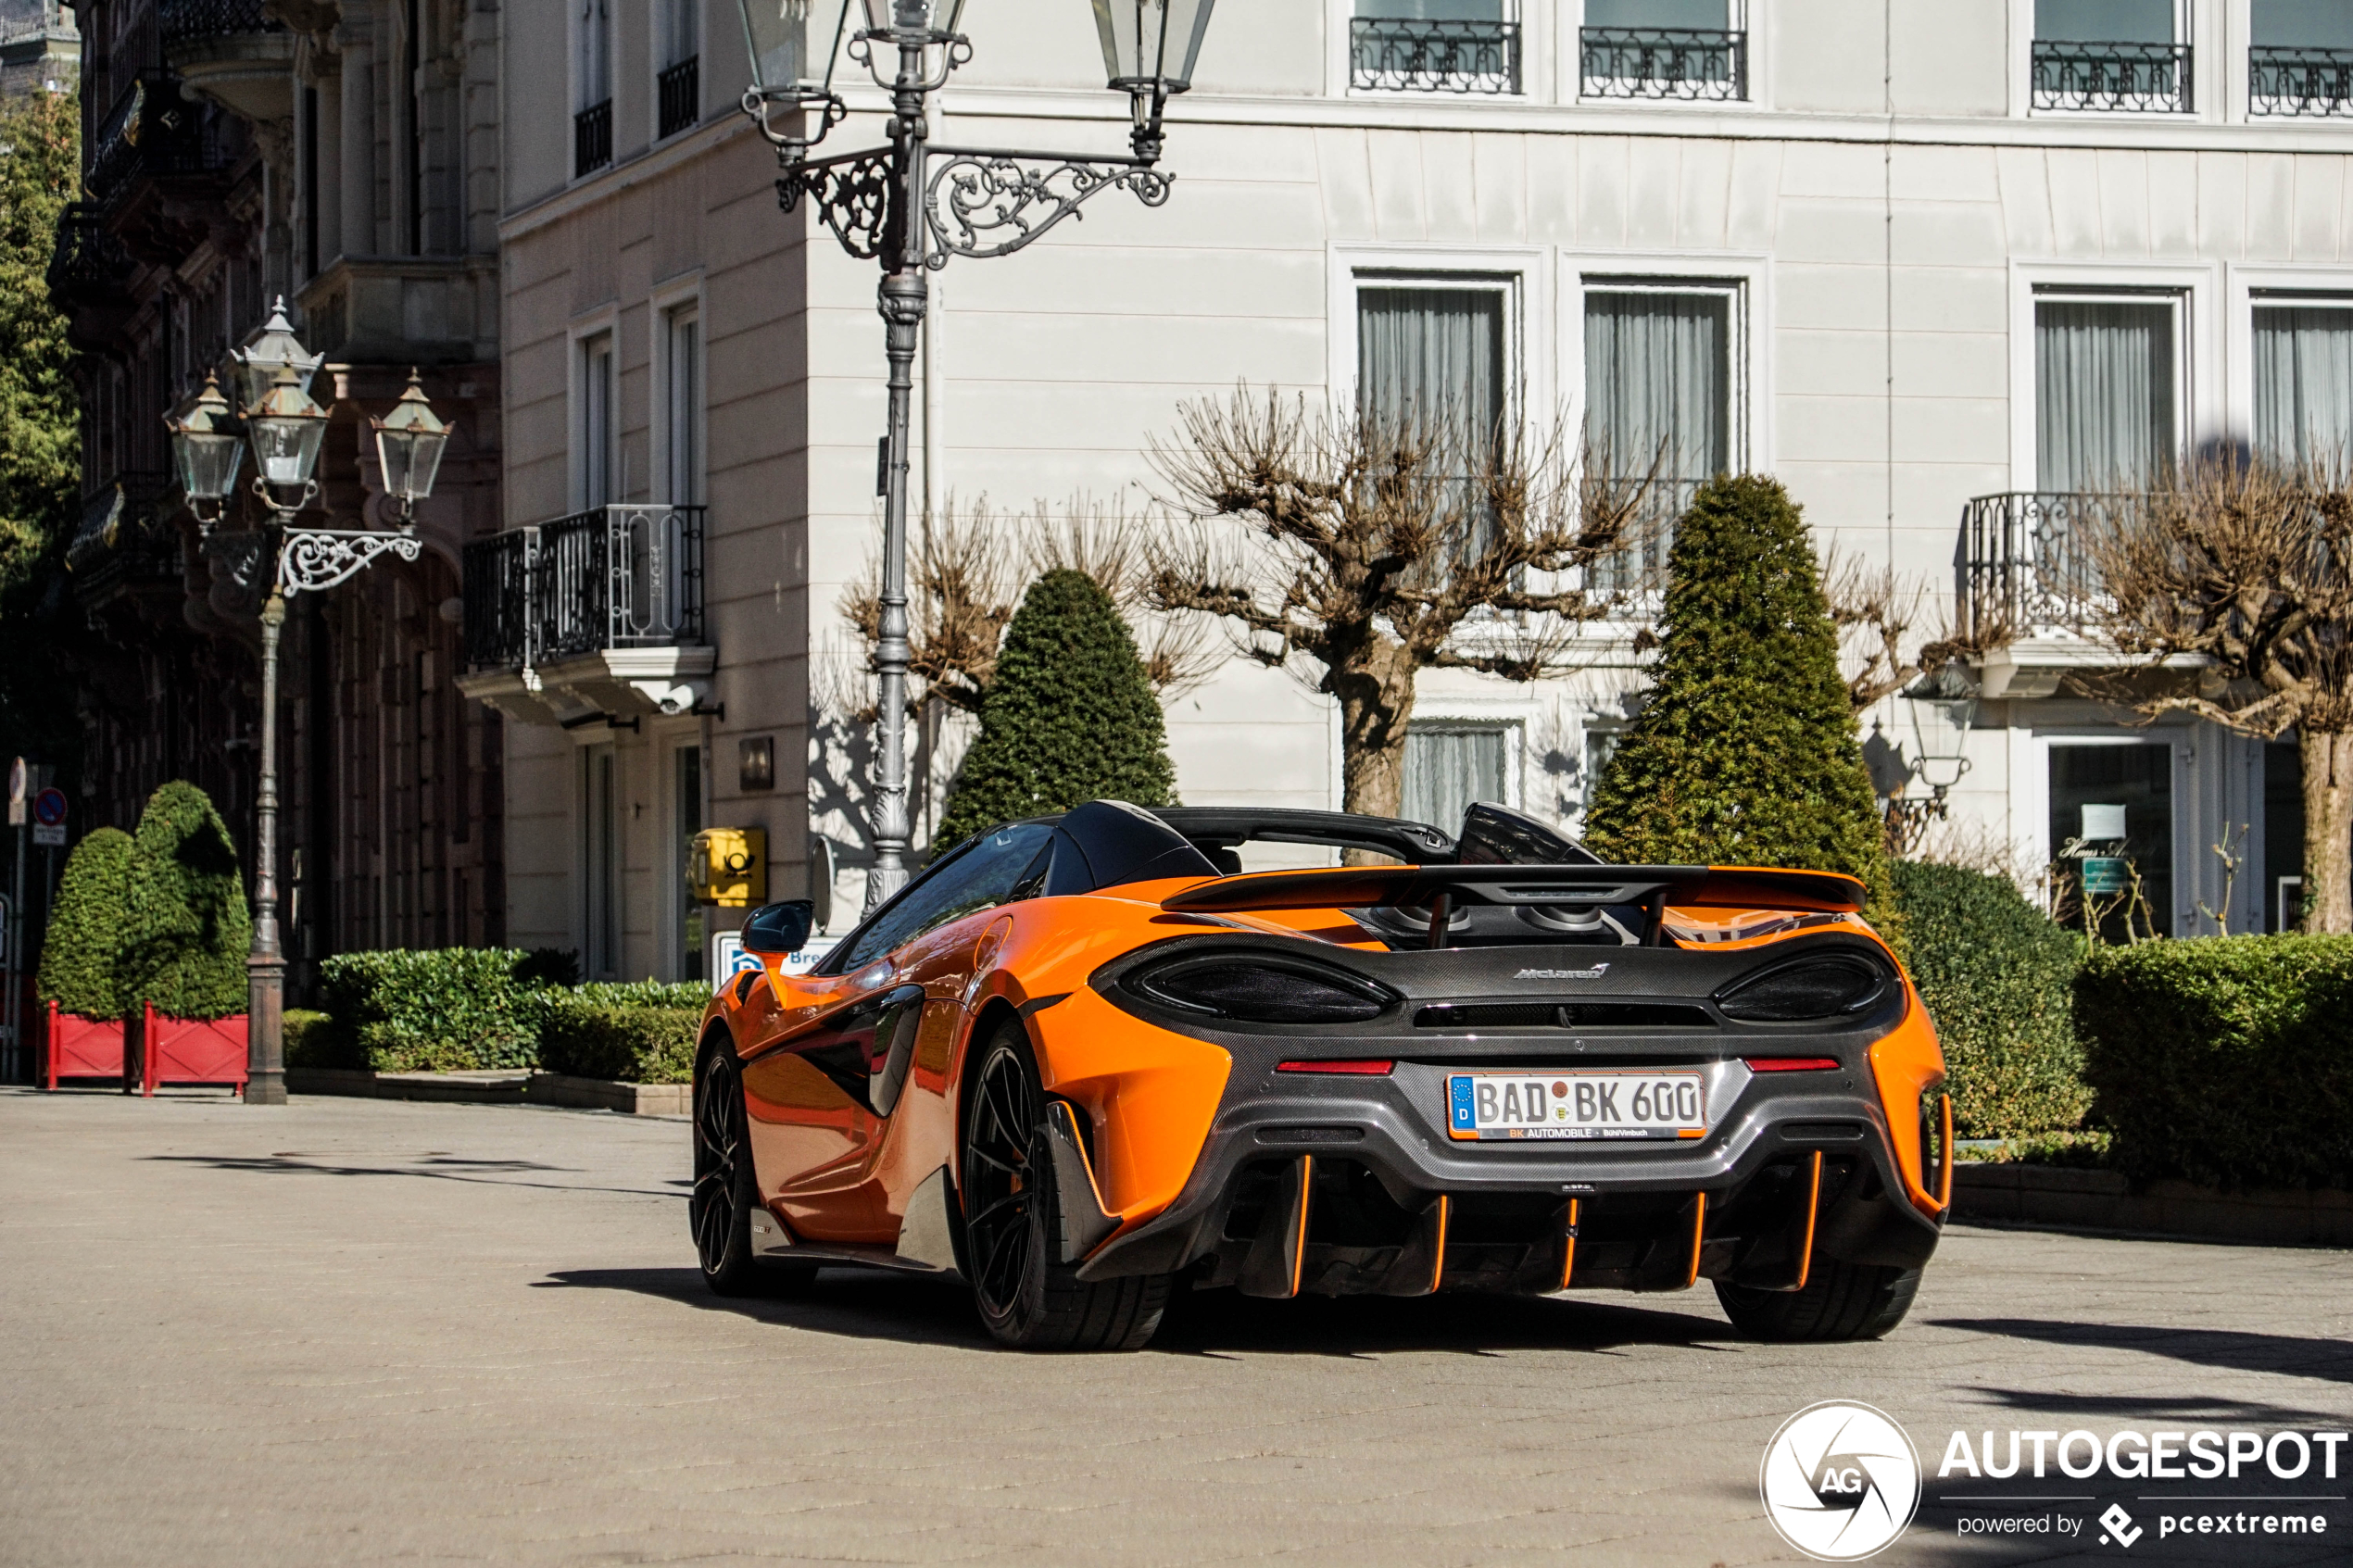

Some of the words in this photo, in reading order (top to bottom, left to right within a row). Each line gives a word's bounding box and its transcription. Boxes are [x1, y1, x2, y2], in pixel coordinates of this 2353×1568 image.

[1514, 969, 1601, 979] McLaren
[1476, 1083, 1547, 1123] BAD
[1575, 1082, 1622, 1122] BK
[1631, 1082, 1697, 1121] 600
[1459, 1109, 1468, 1120] D
[1509, 1129, 1524, 1138] BK
[1528, 1128, 1592, 1138] AUTOMOBILE
